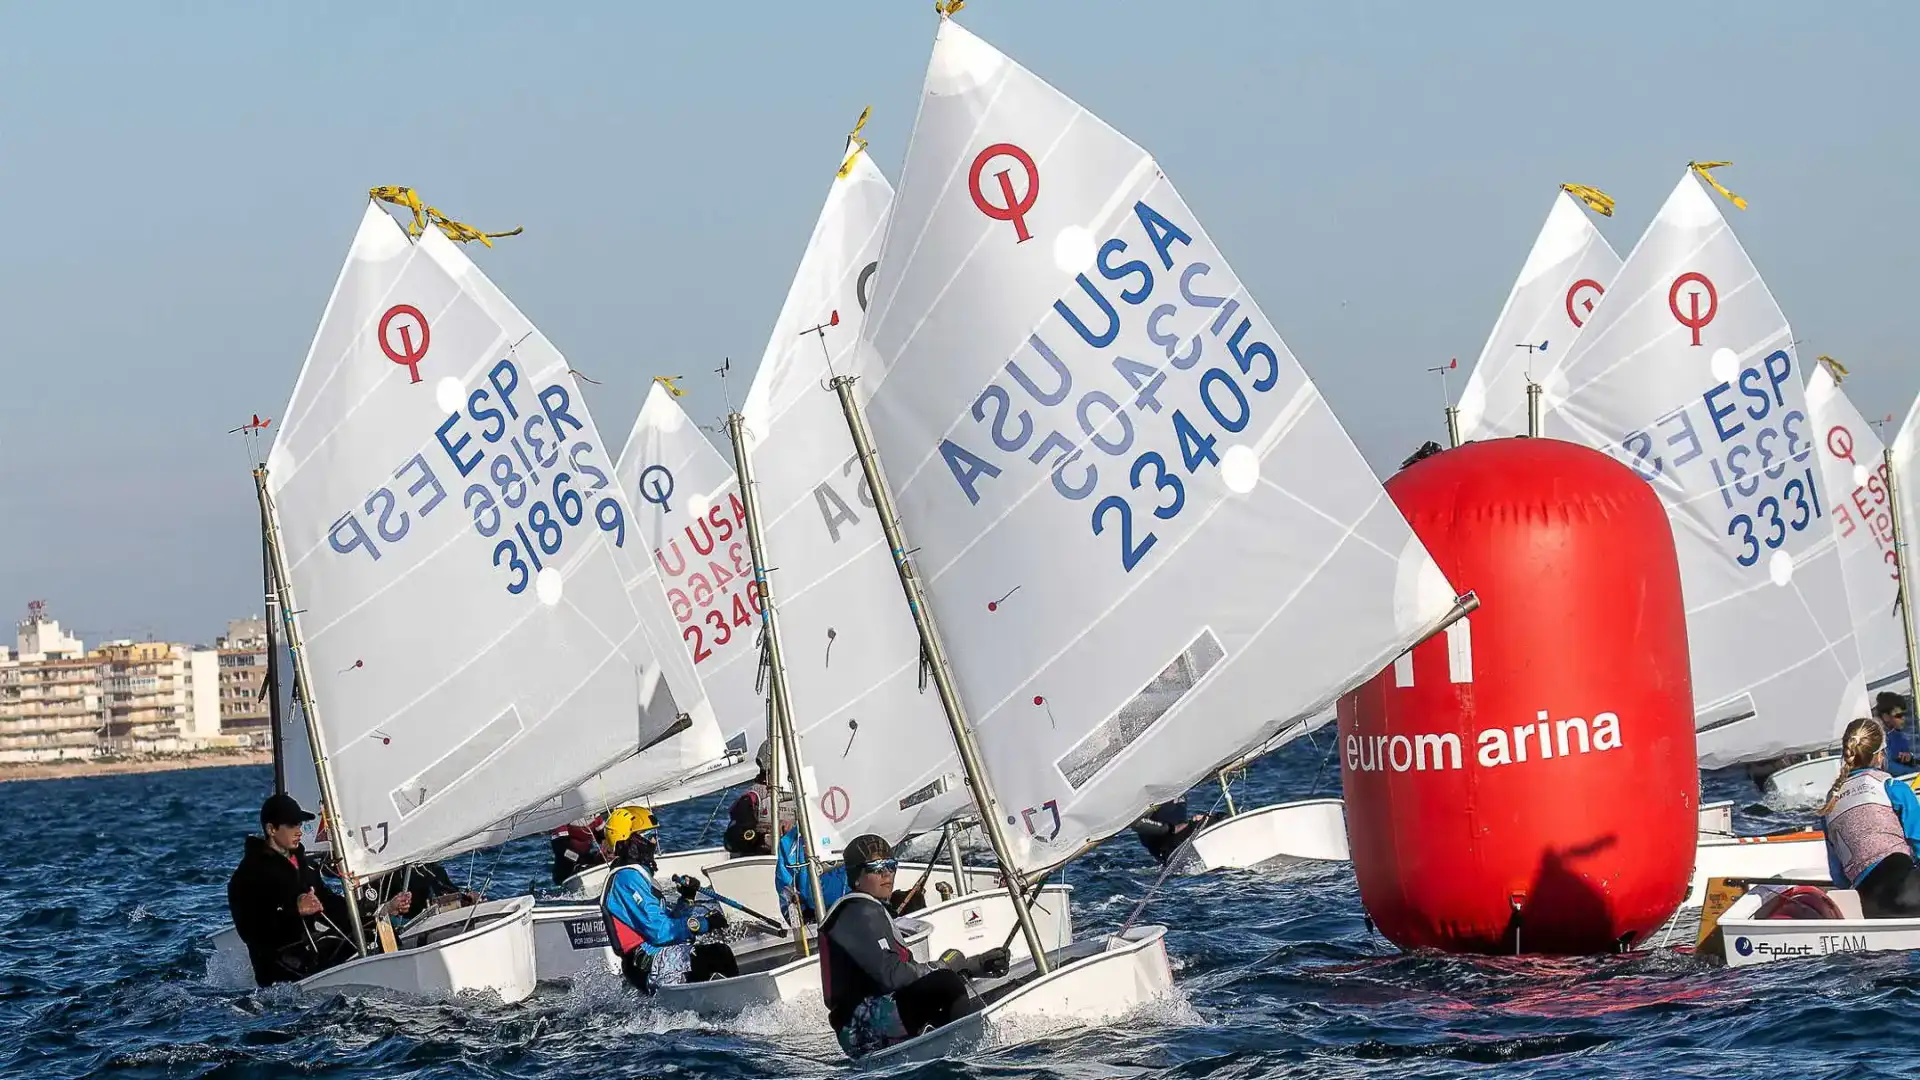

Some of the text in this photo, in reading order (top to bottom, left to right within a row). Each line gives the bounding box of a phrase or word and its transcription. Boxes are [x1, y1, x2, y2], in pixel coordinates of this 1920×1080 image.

[1053, 200, 1192, 349] USA
[434, 359, 519, 477] ESP
[1091, 316, 1279, 572] 23405
[1702, 349, 1791, 442] ESP
[493, 472, 583, 595] 3186
[685, 492, 745, 556] USA
[1727, 467, 1823, 567] 3331
[572, 921, 593, 934] TEAM
[1820, 935, 1867, 954] TEAM
